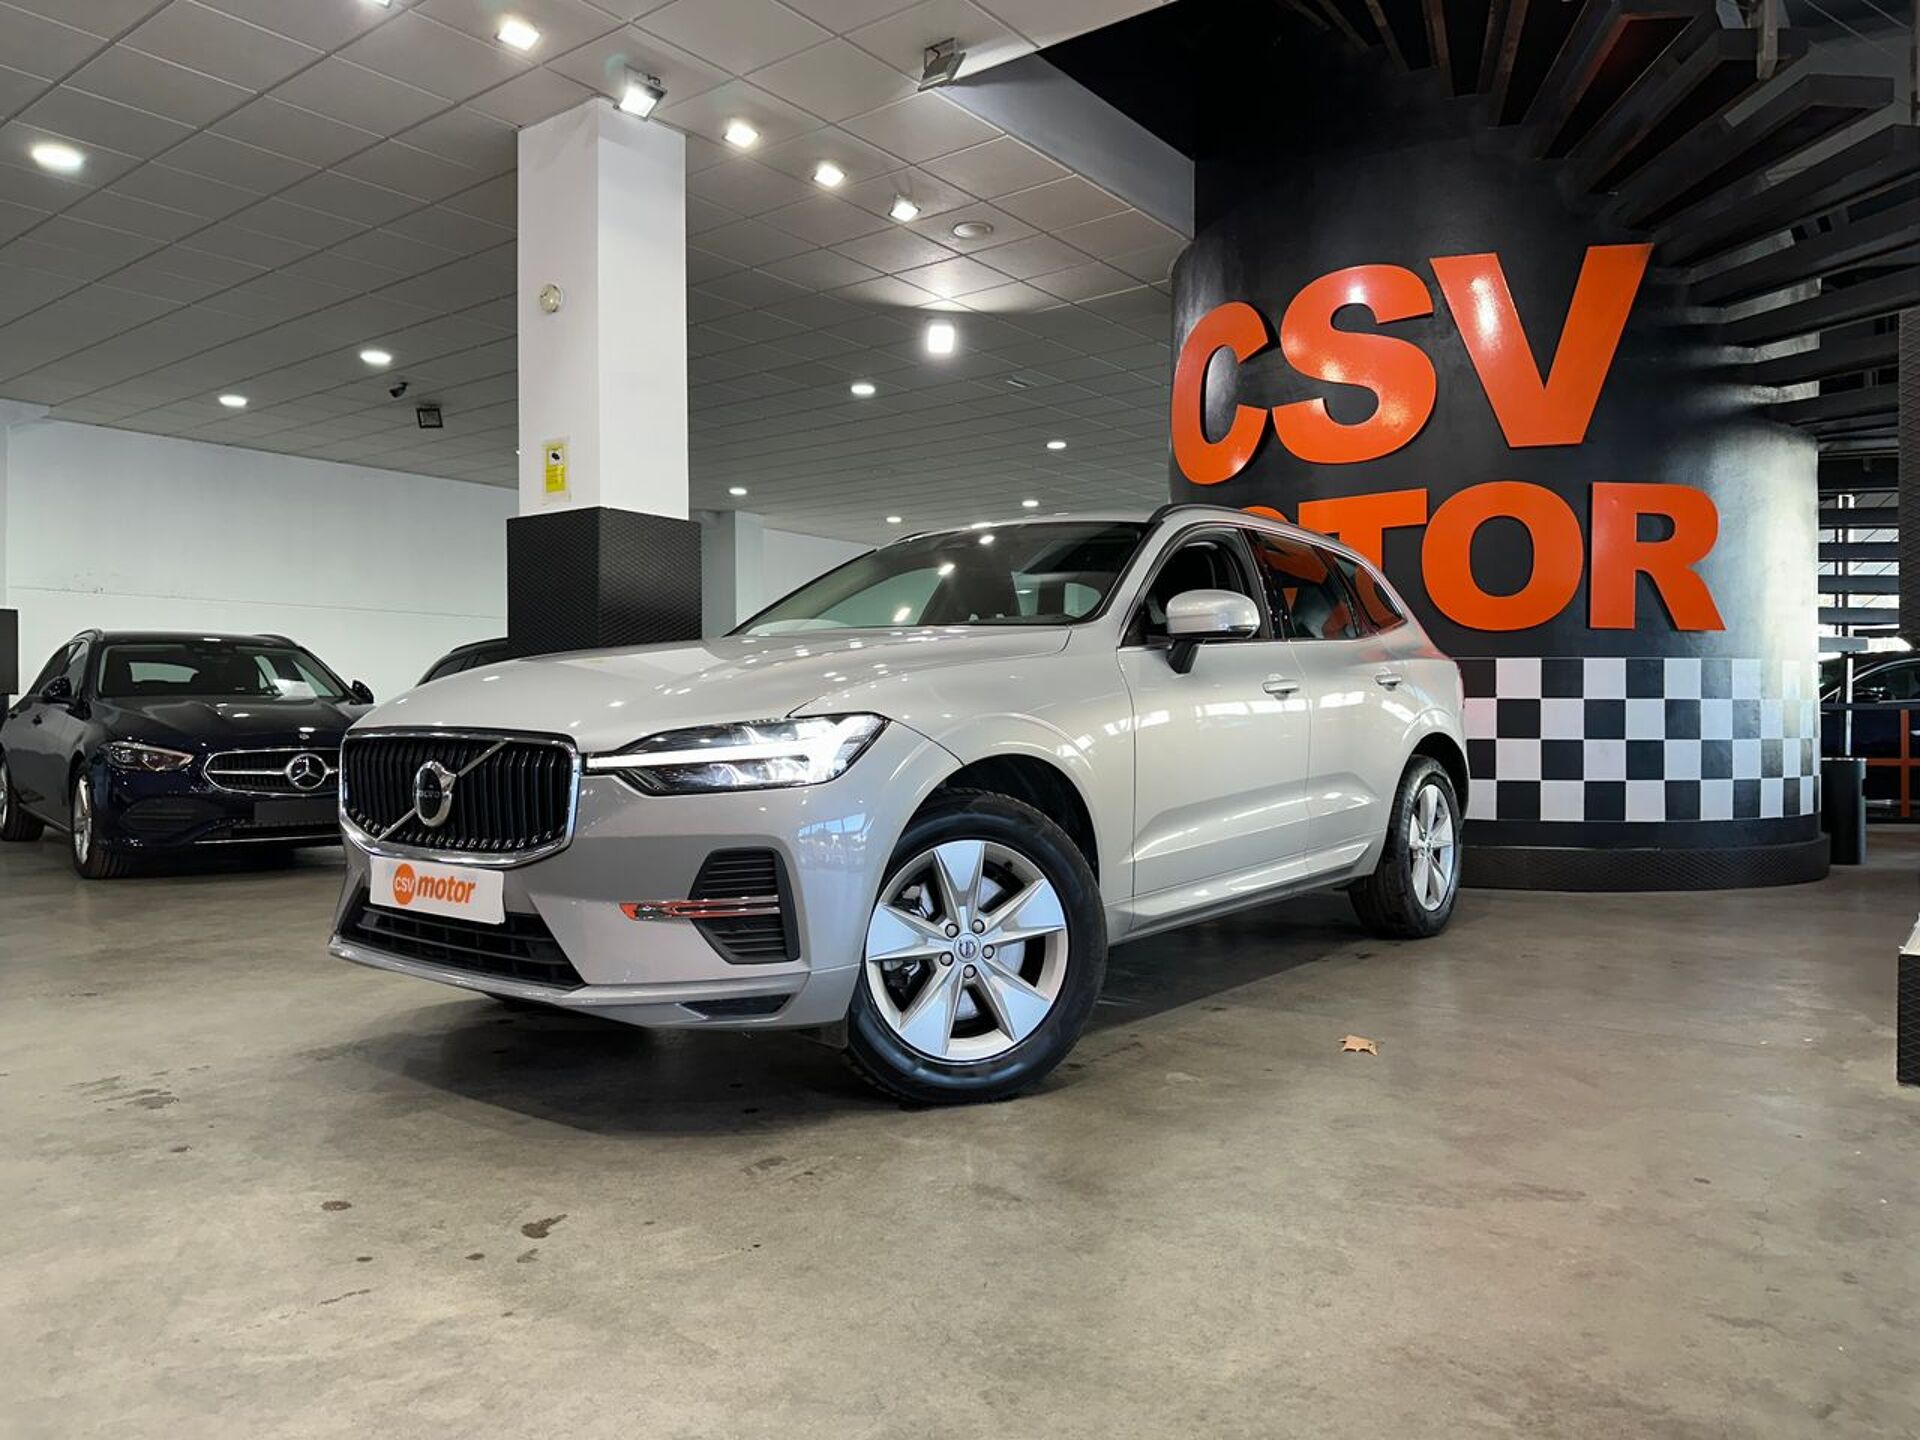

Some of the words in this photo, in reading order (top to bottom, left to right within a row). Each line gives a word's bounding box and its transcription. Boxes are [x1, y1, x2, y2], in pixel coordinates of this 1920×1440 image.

[1172, 243, 1653, 485] CSV
[1241, 482, 1725, 632] TOR
[417, 875, 476, 904] motor
